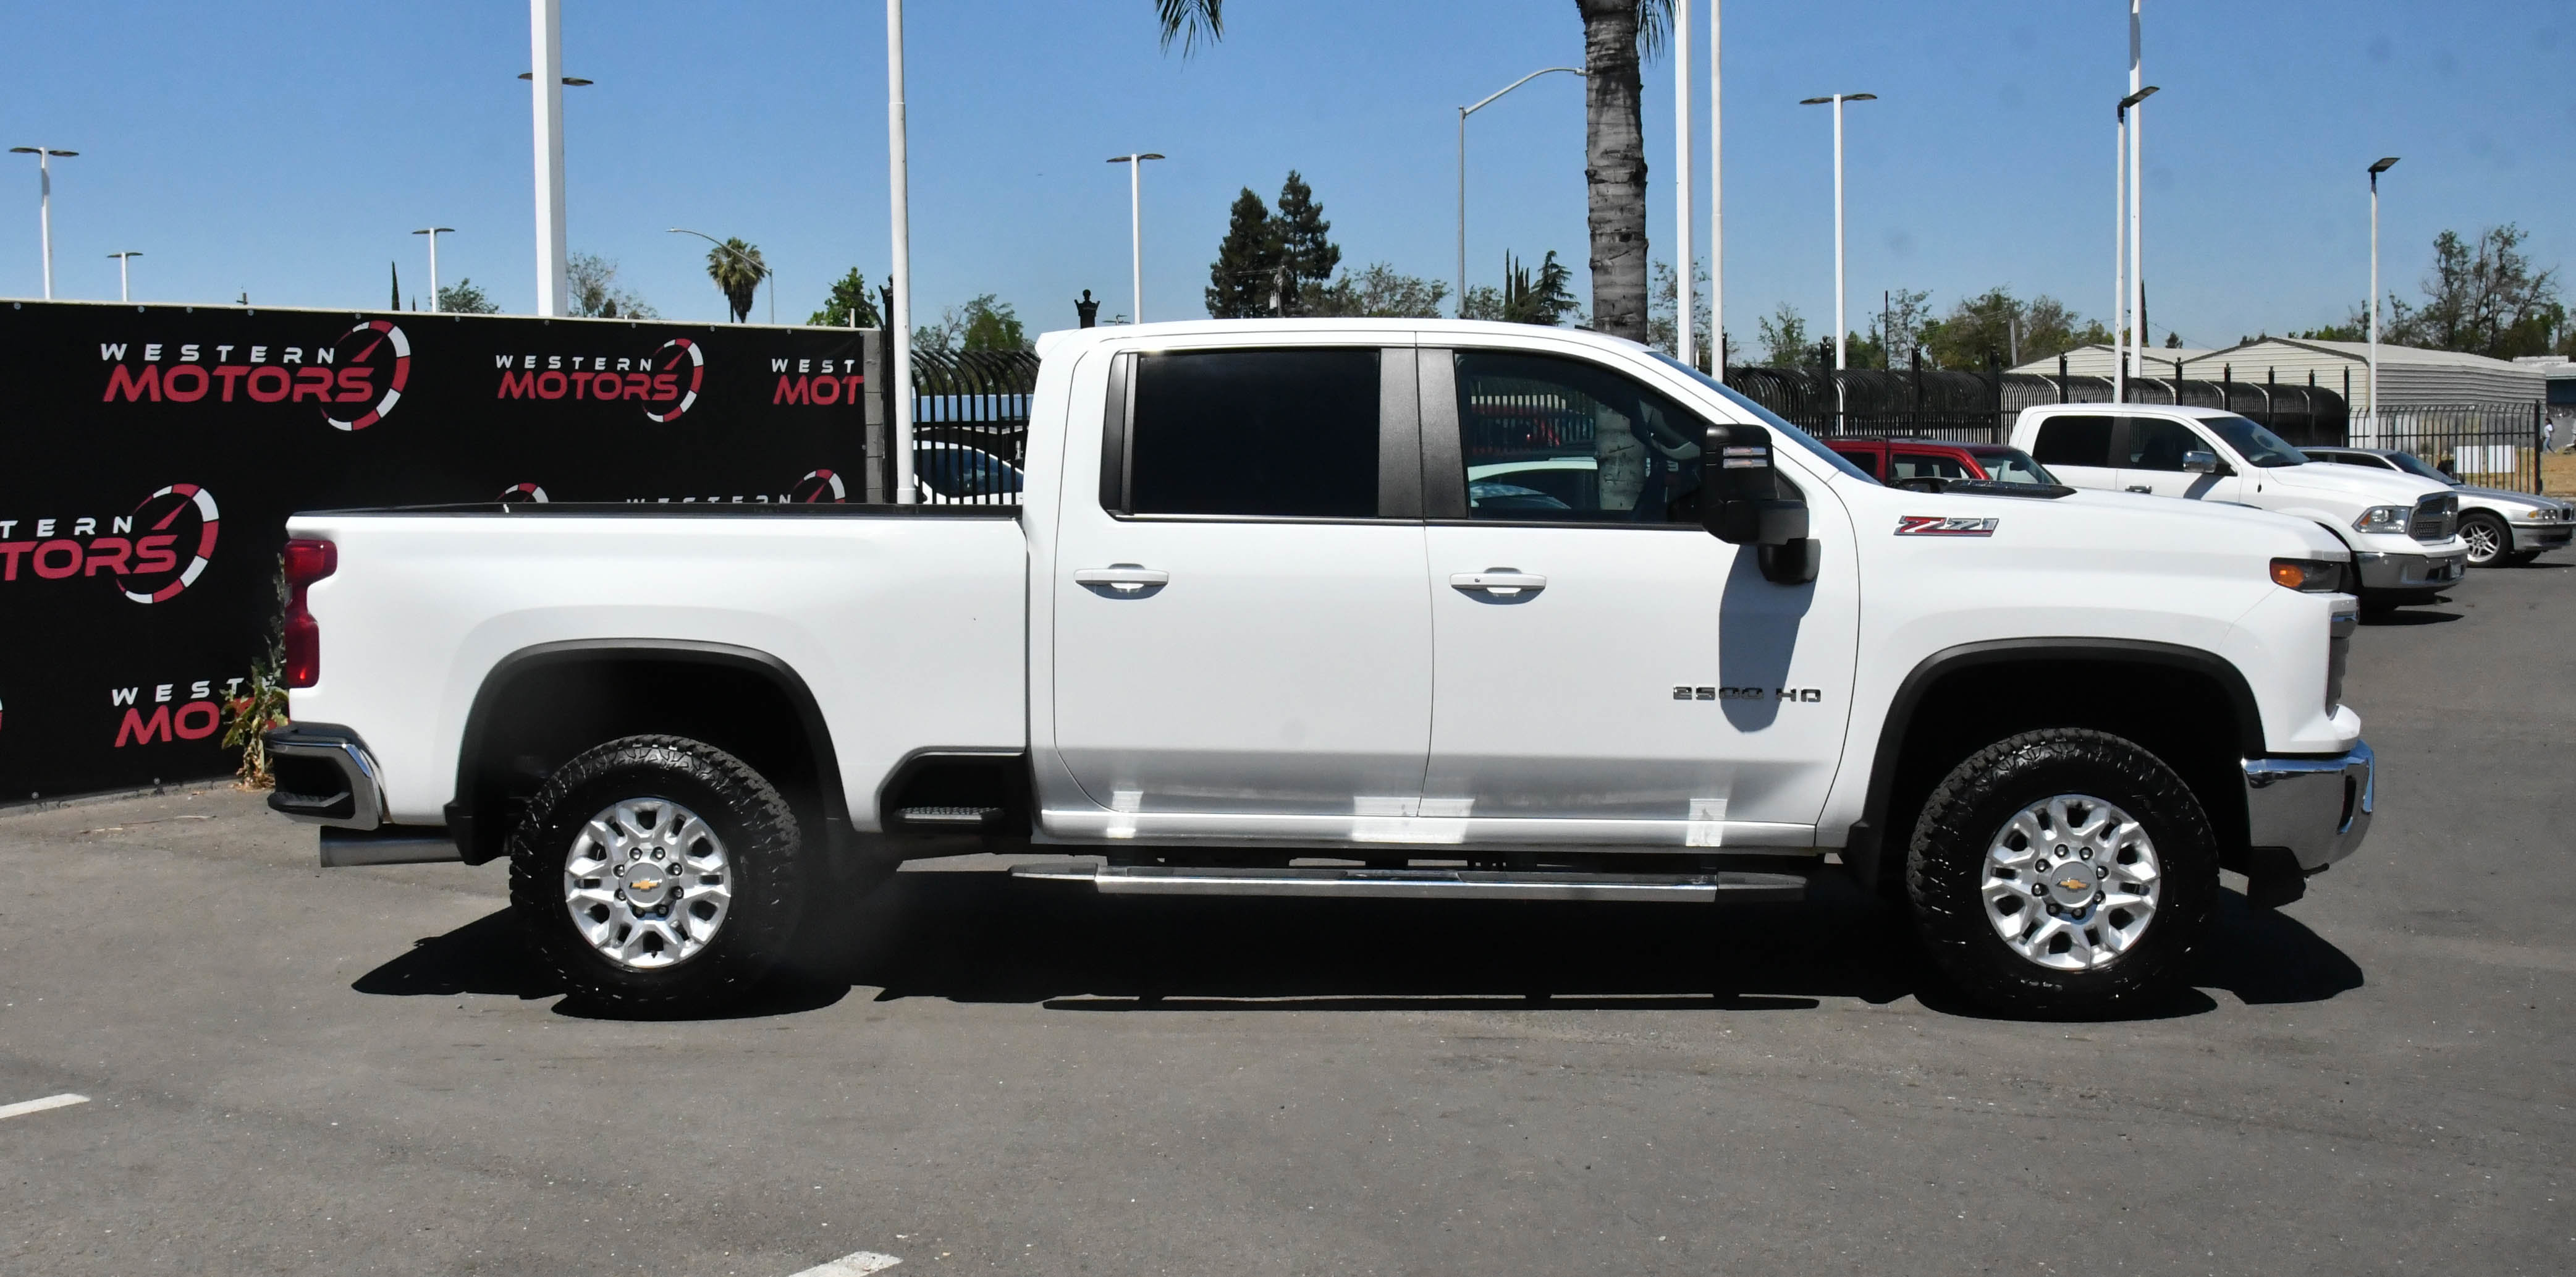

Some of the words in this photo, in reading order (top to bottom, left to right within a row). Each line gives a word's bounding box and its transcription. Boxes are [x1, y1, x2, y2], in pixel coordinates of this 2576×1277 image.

[101, 343, 334, 364] WESTERN
[496, 355, 652, 371] WESTERN
[771, 358, 855, 373] WEST
[103, 364, 374, 402] MOTORS
[498, 370, 678, 401] MOTORS
[773, 375, 864, 405] MOT
[1893, 515, 1999, 537] Z71
[1673, 685, 1763, 700] 2500
[1776, 688, 1821, 703] HD
